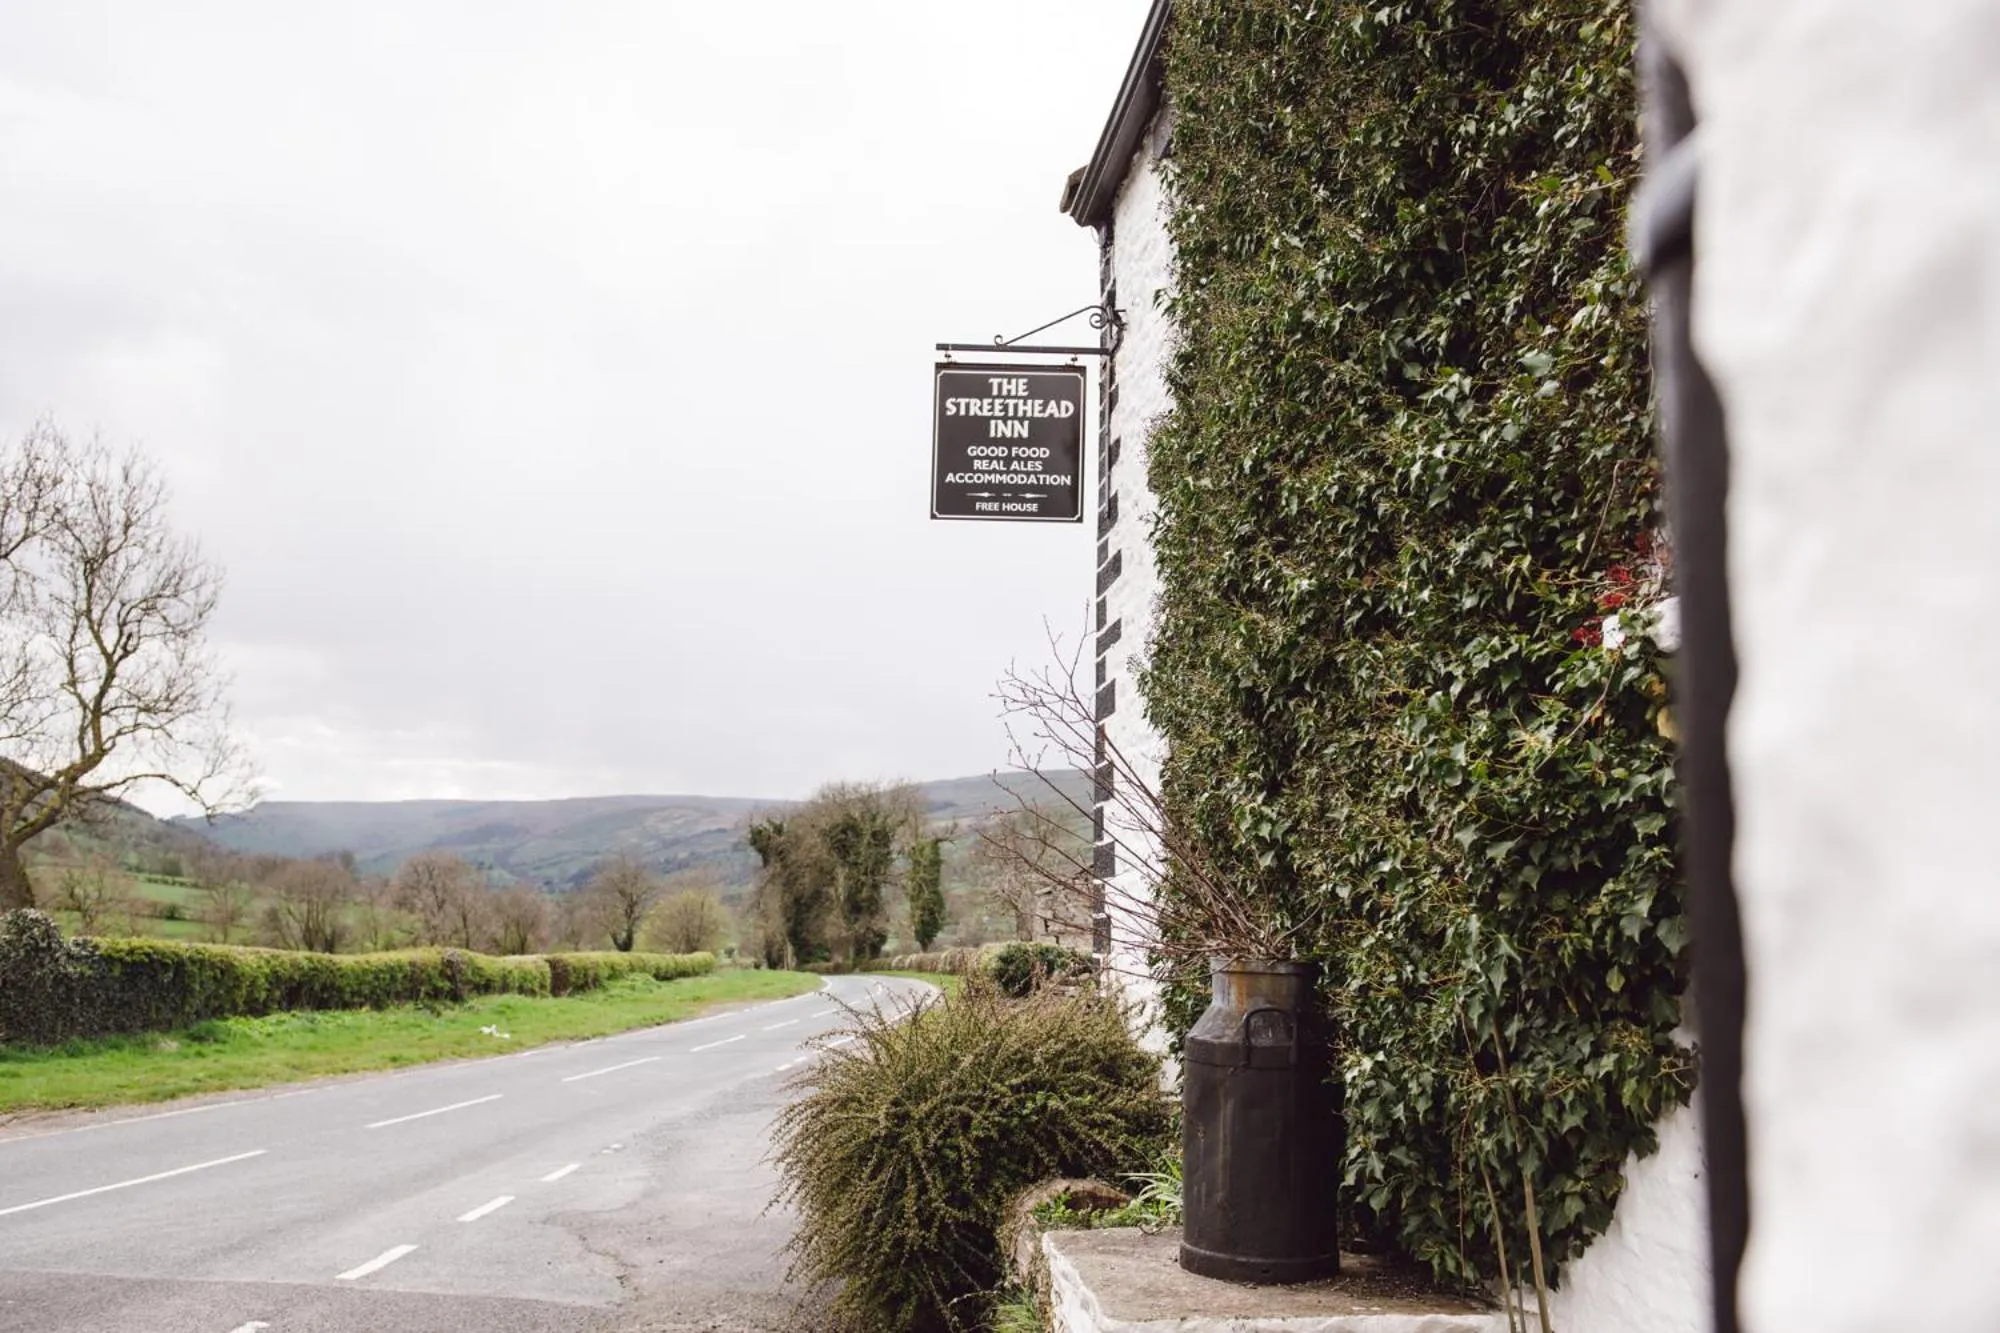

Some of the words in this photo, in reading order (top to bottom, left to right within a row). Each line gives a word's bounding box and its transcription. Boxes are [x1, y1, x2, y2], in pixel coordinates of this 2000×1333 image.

[989, 378, 1029, 396] THE
[945, 398, 1075, 418] STREETHEAD
[989, 420, 1029, 438] INN
[968, 446, 1008, 457] GOOD
[1012, 447, 1050, 458] FOOD
[973, 460, 1007, 470] REAL
[1010, 461, 1043, 471] ALES
[945, 473, 1071, 485] ACCOMMODATION
[975, 502, 999, 511] FREE
[1002, 503, 1038, 512] HOUSE
